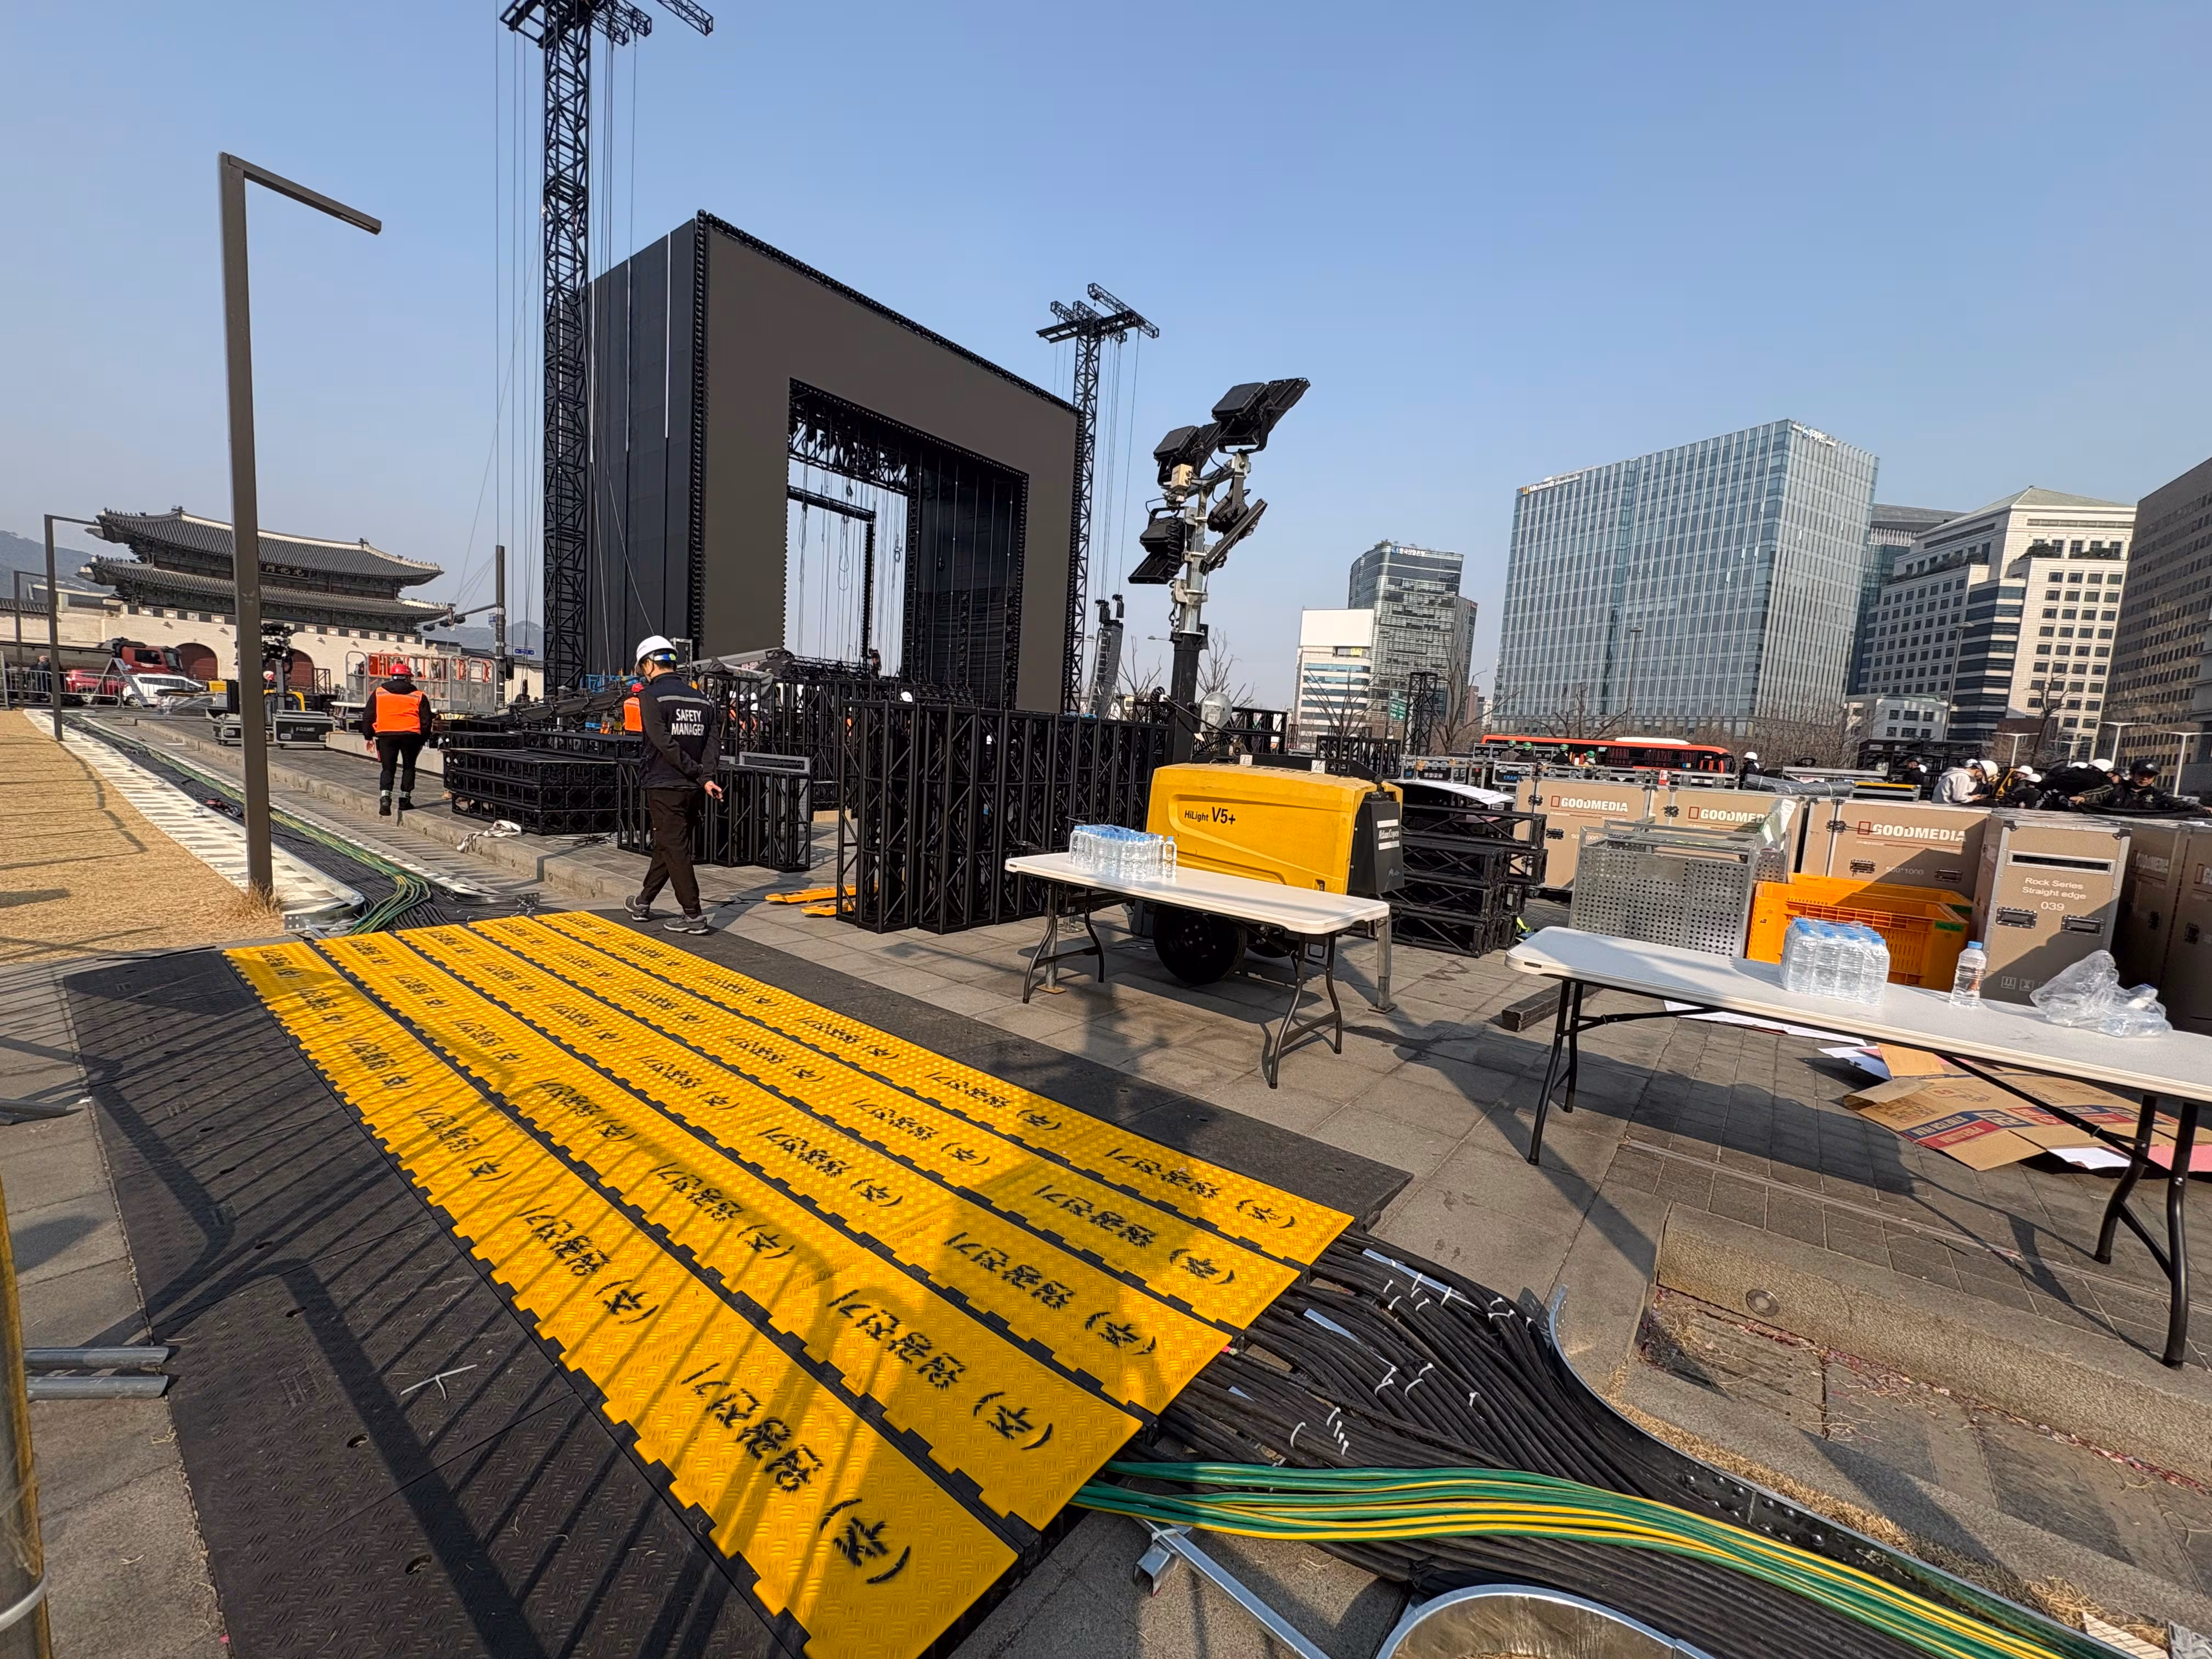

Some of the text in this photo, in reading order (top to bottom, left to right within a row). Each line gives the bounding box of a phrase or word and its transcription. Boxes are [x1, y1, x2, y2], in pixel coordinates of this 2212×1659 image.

[676, 708, 702, 722] SAFETY
[671, 723, 704, 736] MANAGER
[1560, 797, 1629, 813] GOODMEDIA
[1184, 806, 1236, 825] HiLight V5+
[1700, 808, 1767, 824] GOODMED
[1871, 823, 1966, 842] GOODMEDIA
[2024, 877, 2084, 890] Rock Series
[2021, 886, 2086, 900] Straight edge
[2040, 901, 2065, 912] 039
